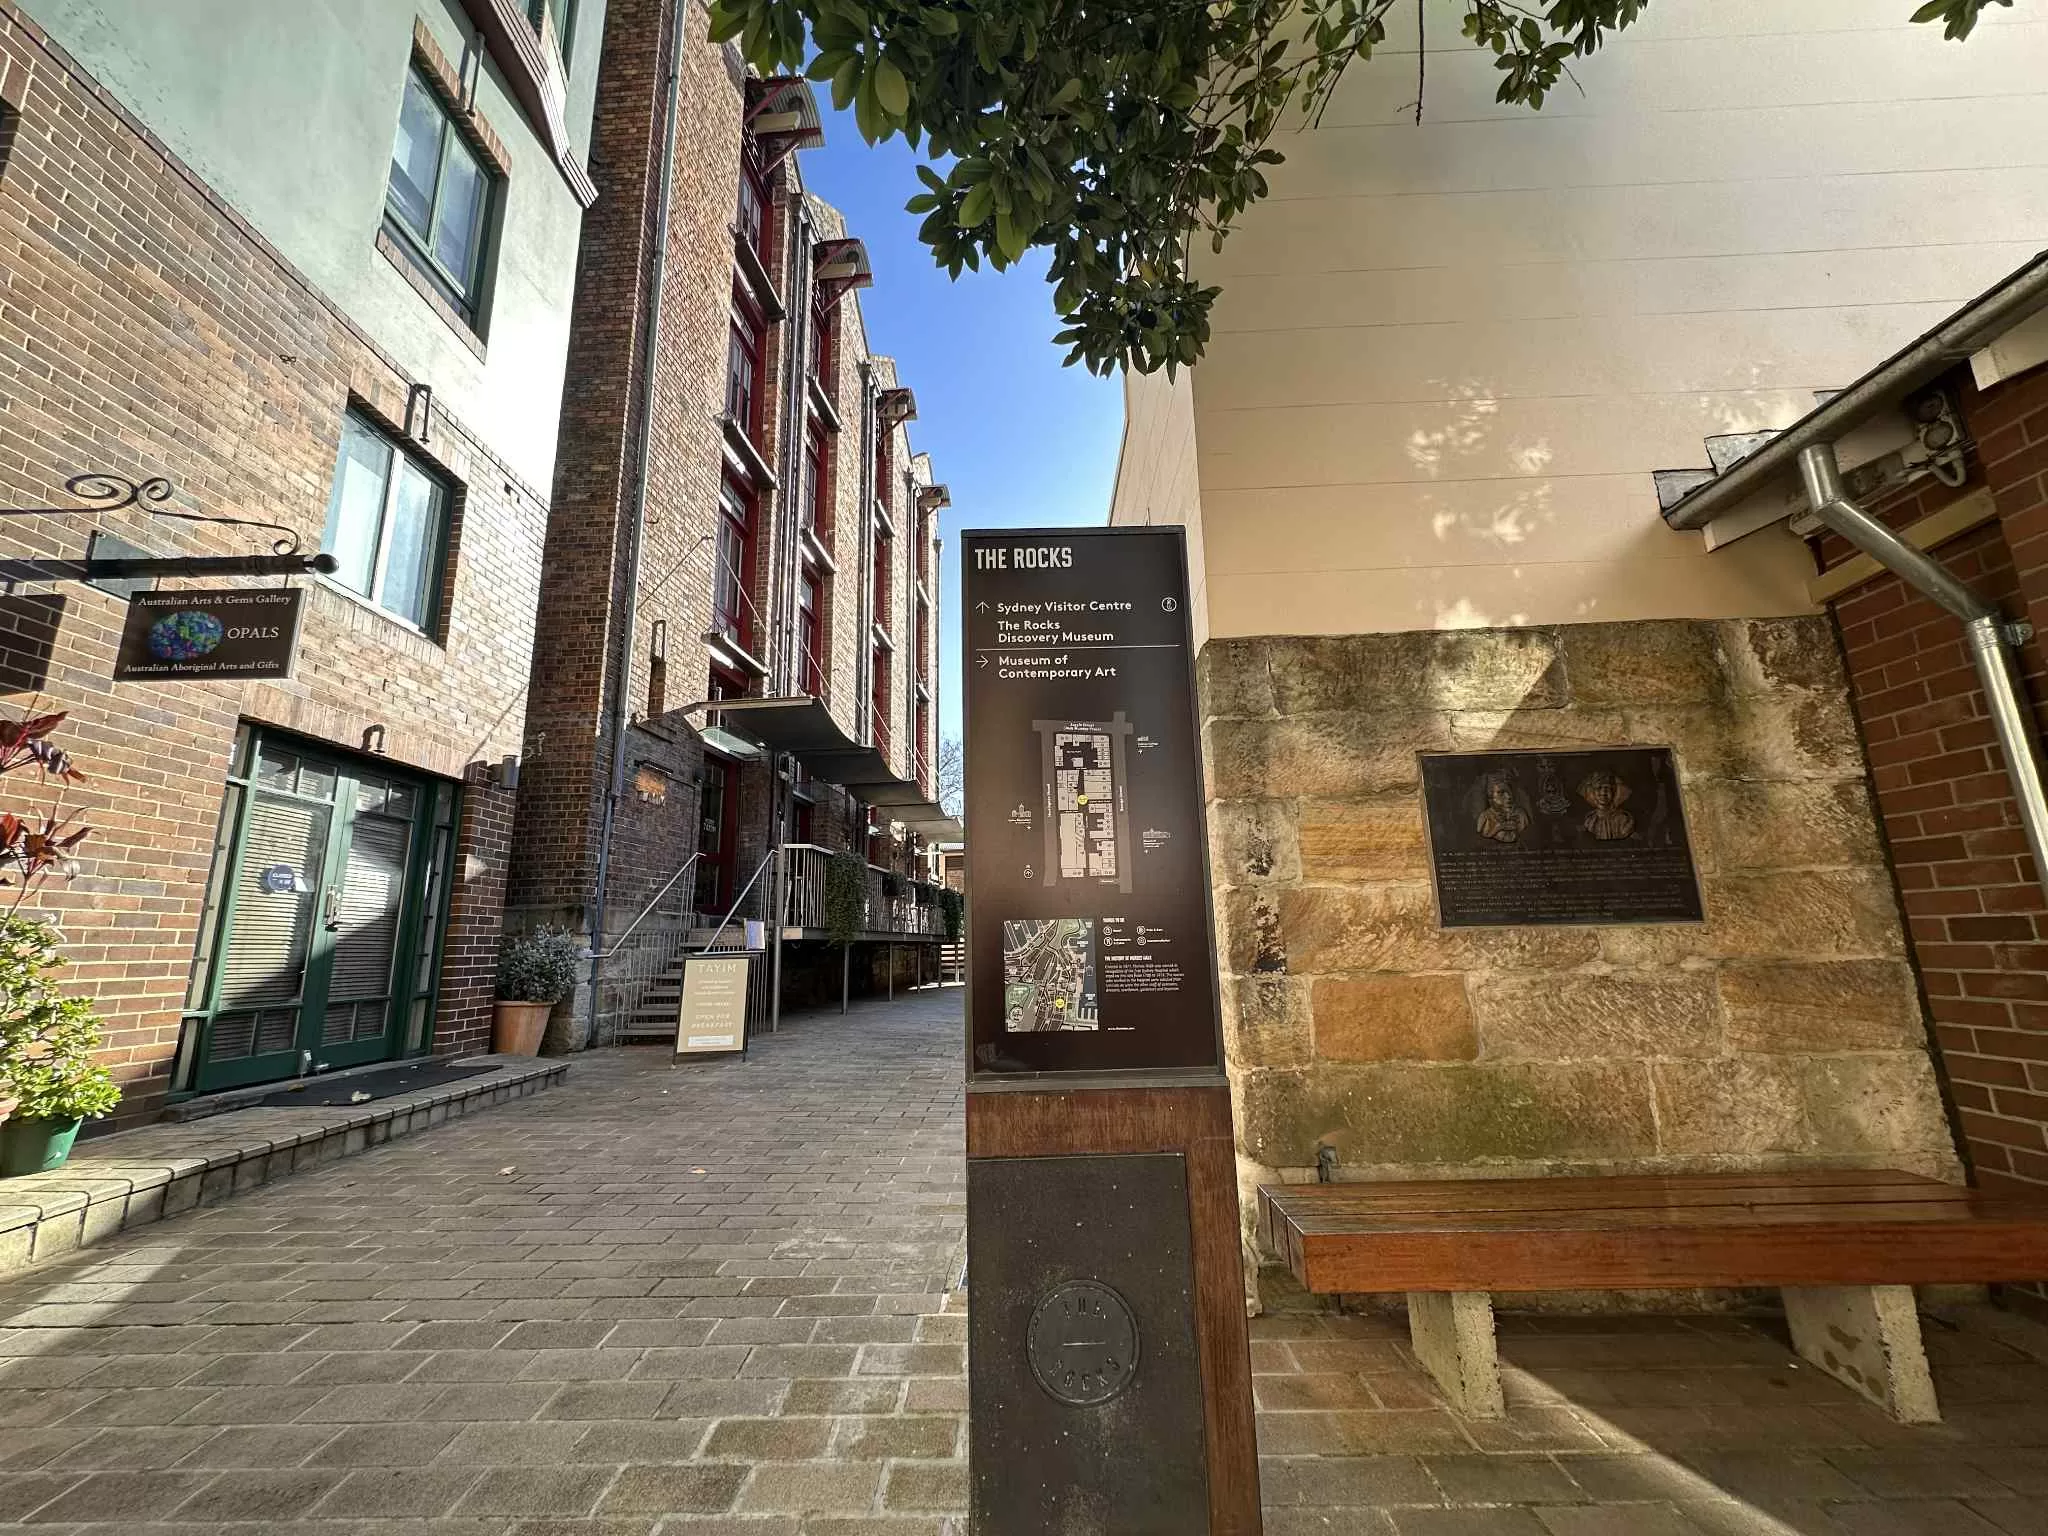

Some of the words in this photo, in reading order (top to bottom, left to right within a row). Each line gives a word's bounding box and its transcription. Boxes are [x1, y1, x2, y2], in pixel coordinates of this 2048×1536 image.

[975, 548, 1008, 569] THE
[1013, 547, 1073, 569] ROCKS
[138, 597, 188, 606] Australian
[191, 597, 212, 605] Arts
[214, 596, 222, 604] &
[226, 596, 253, 604] Gems
[256, 595, 292, 606] Gallery
[997, 602, 1041, 615] Sydney
[1044, 601, 1086, 612] Visitor
[1089, 600, 1132, 611] Centre
[998, 621, 1020, 630] The
[1024, 620, 1061, 630] Rocks
[227, 627, 280, 640] OPALS
[998, 633, 1059, 645] Discovery
[1062, 631, 1114, 643] Museum
[999, 655, 1051, 666] Museum
[1054, 654, 1068, 665] of
[124, 664, 169, 673] Australian
[171, 663, 217, 673] Aboriginal
[219, 662, 237, 671] Arts
[239, 661, 255, 670] and
[257, 661, 280, 669] Gifts
[998, 667, 1091, 681] Contemporary
[1094, 667, 1116, 677] Art
[696, 963, 737, 974] TAYIM
